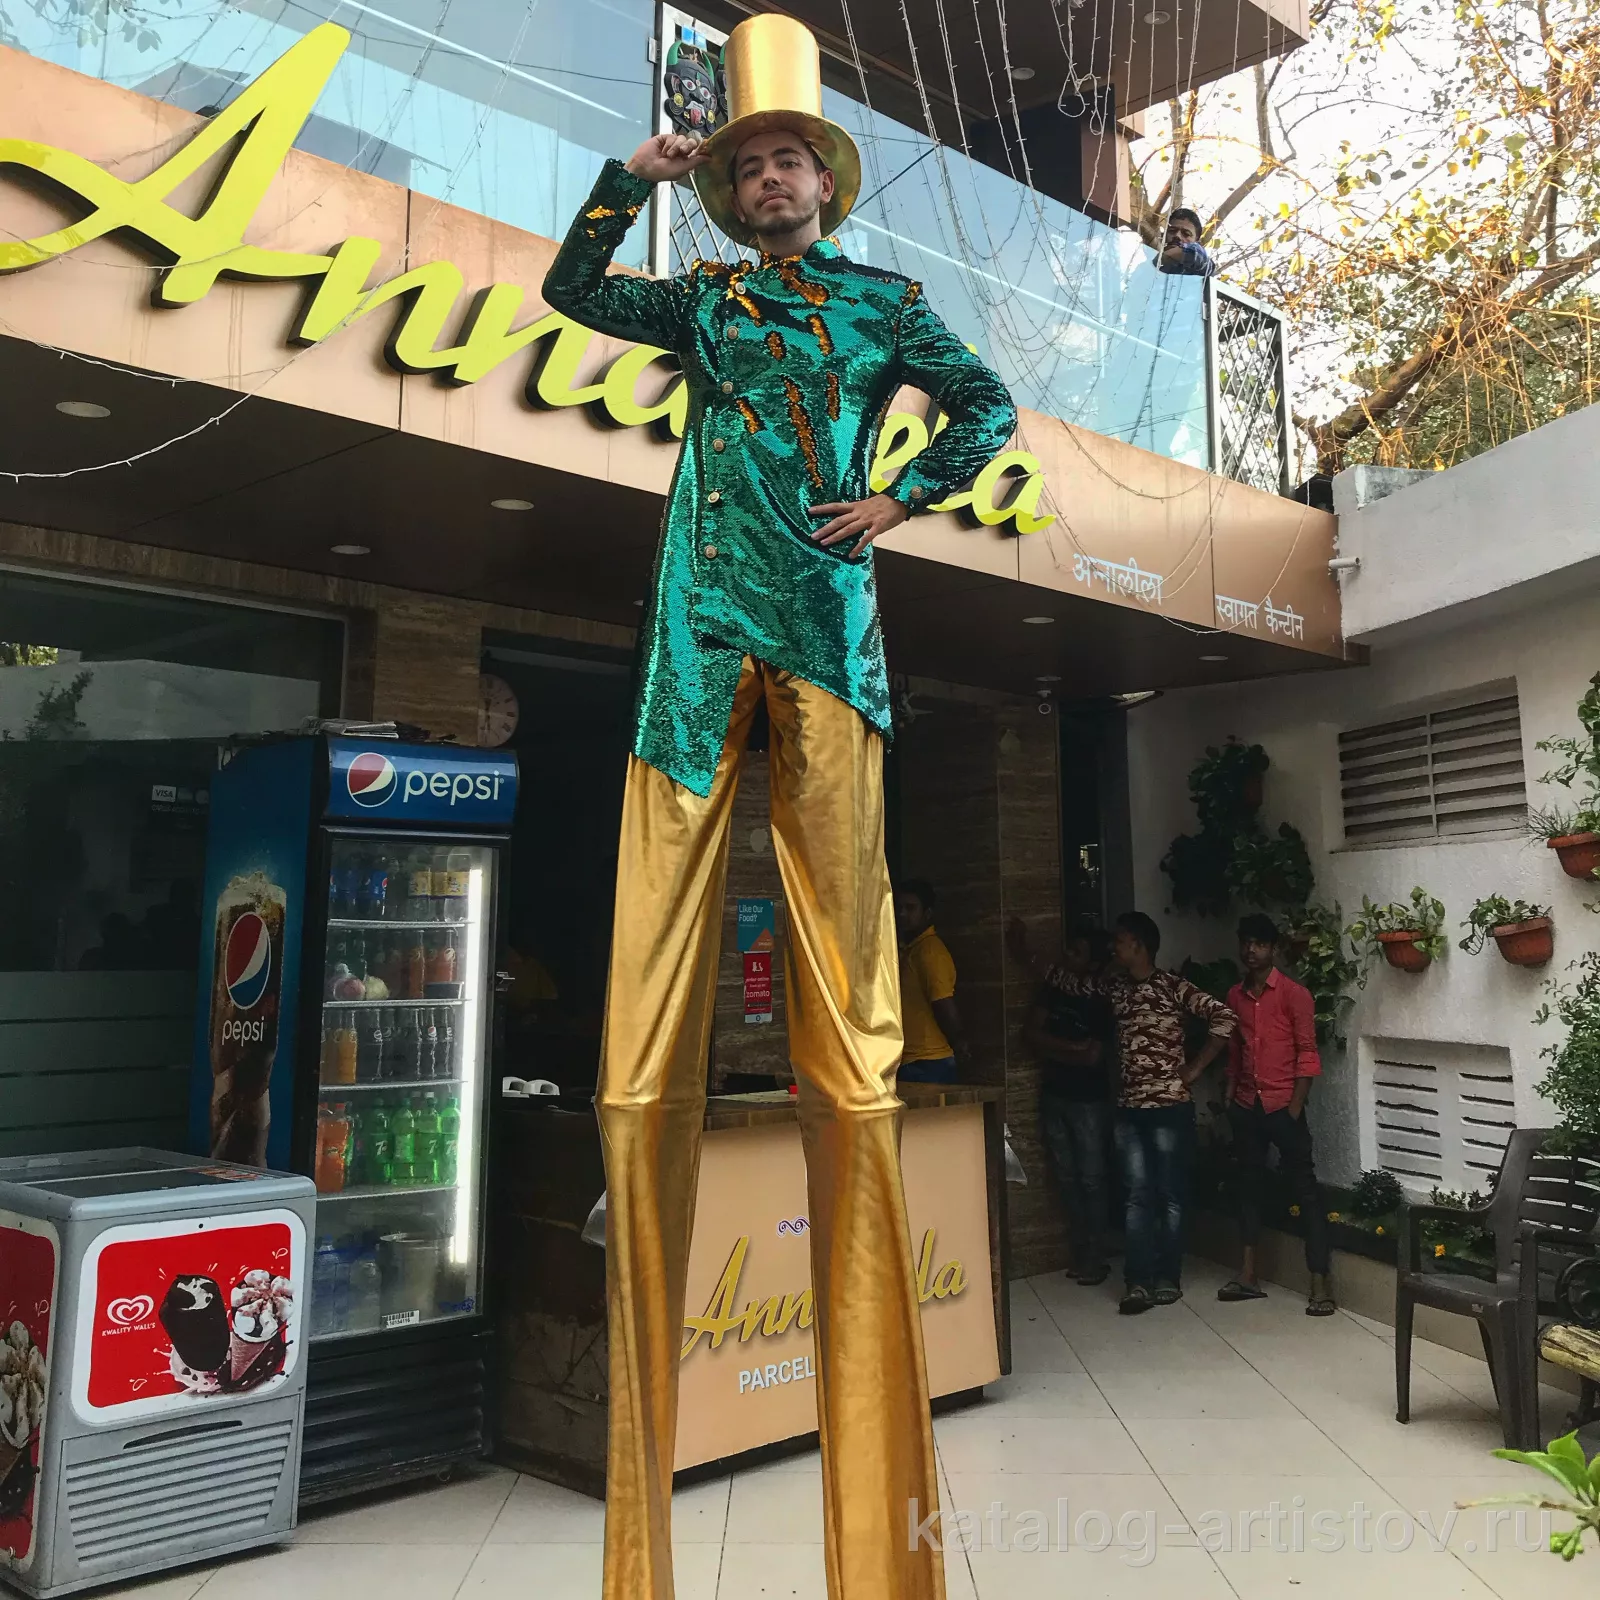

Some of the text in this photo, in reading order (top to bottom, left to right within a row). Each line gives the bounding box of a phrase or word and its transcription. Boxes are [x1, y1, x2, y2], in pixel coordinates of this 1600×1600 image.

[1215, 594, 1304, 640] स्वागत कैन्टीन
[155, 788, 174, 798] VISA
[403, 770, 500, 806] pepsi
[739, 904, 763, 913] Like Our
[739, 913, 758, 922] Food?
[746, 990, 770, 998] zomato
[222, 1016, 265, 1047] pepsi
[101, 1322, 156, 1337] KWALITY WALL'S
[738, 1356, 815, 1394] PARCEL
